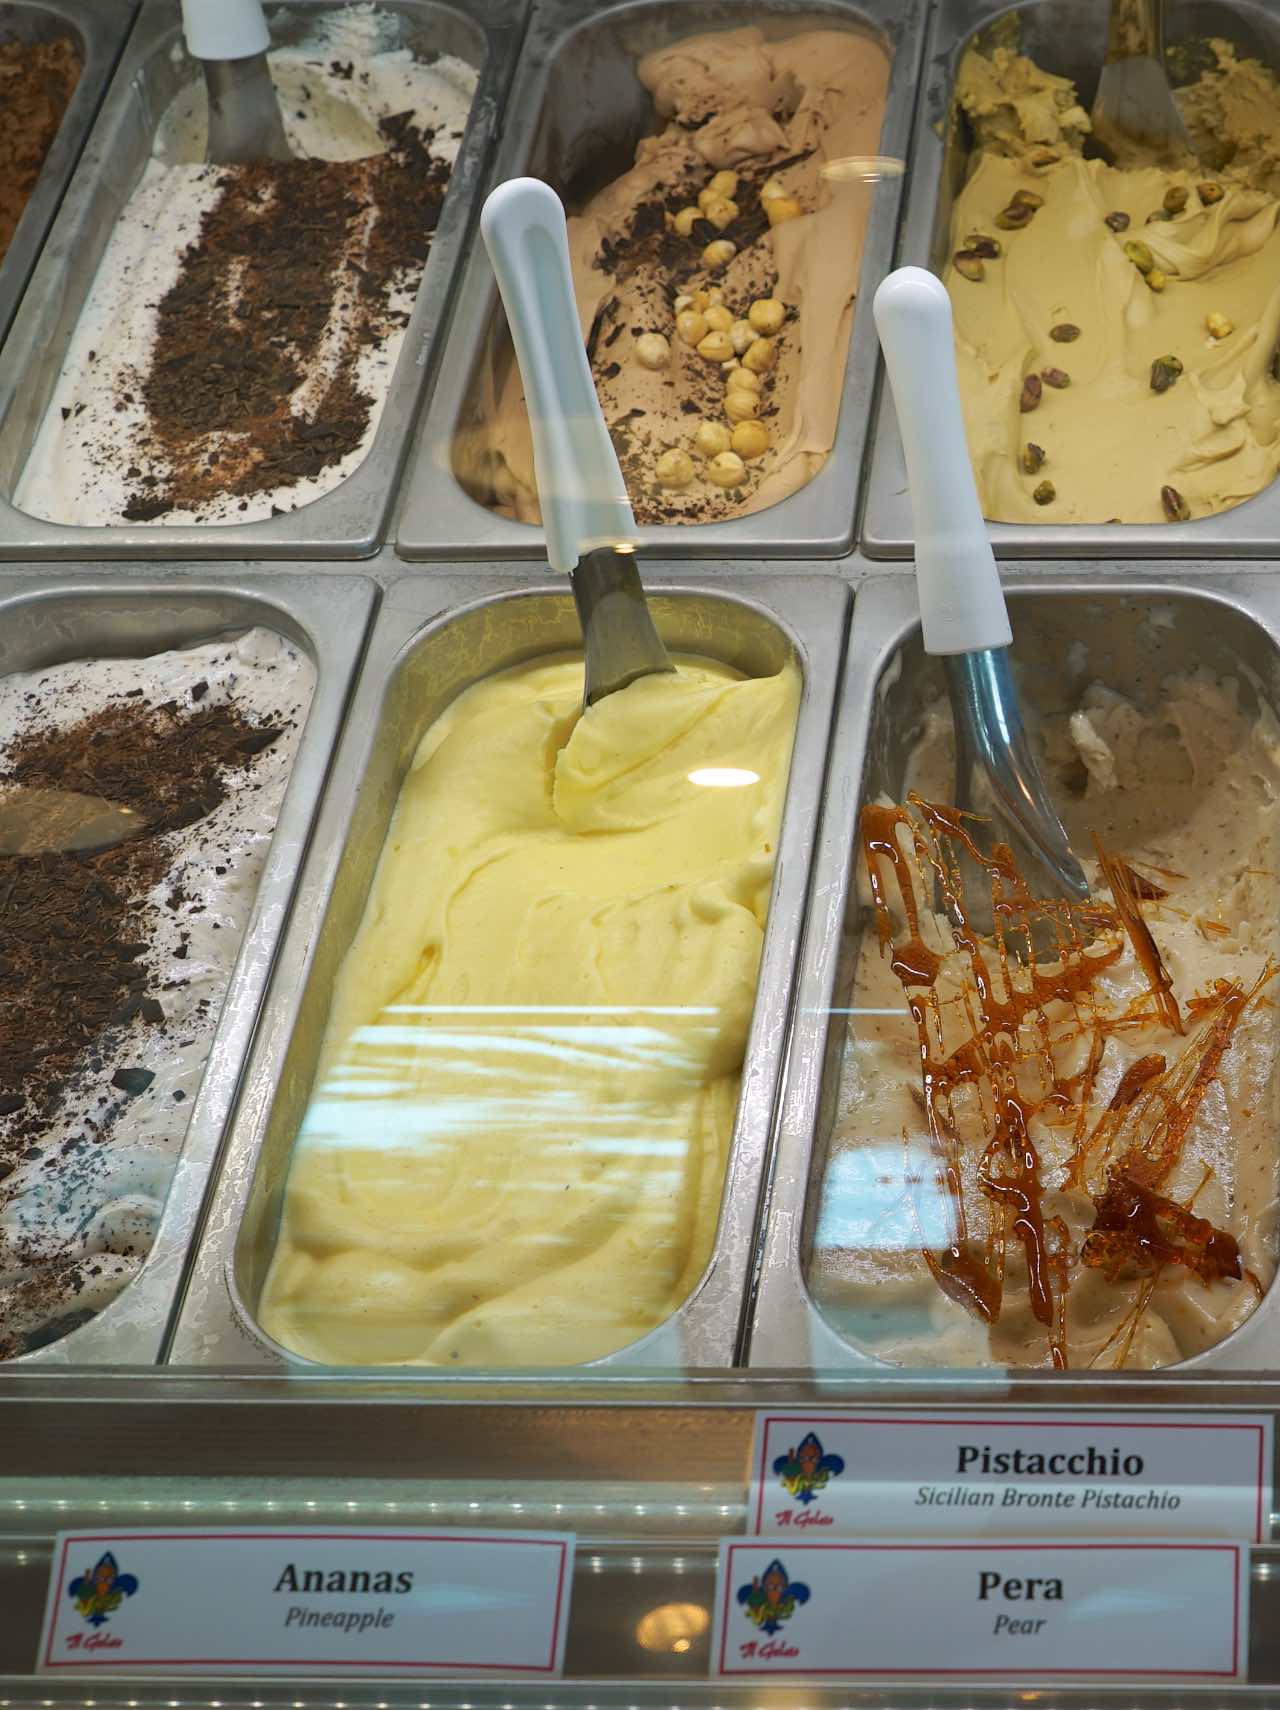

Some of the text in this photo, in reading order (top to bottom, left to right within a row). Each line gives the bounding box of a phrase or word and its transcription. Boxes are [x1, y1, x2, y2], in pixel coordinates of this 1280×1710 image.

[956, 1445, 1145, 1477] Pistacchio
[914, 1486, 1182, 1511] Sicilian Bronte Pistachio
[273, 1562, 414, 1595] Ananas
[977, 1571, 1064, 1602] Pera
[284, 1605, 395, 1631] Pineapple
[992, 1613, 1047, 1636] Pear
